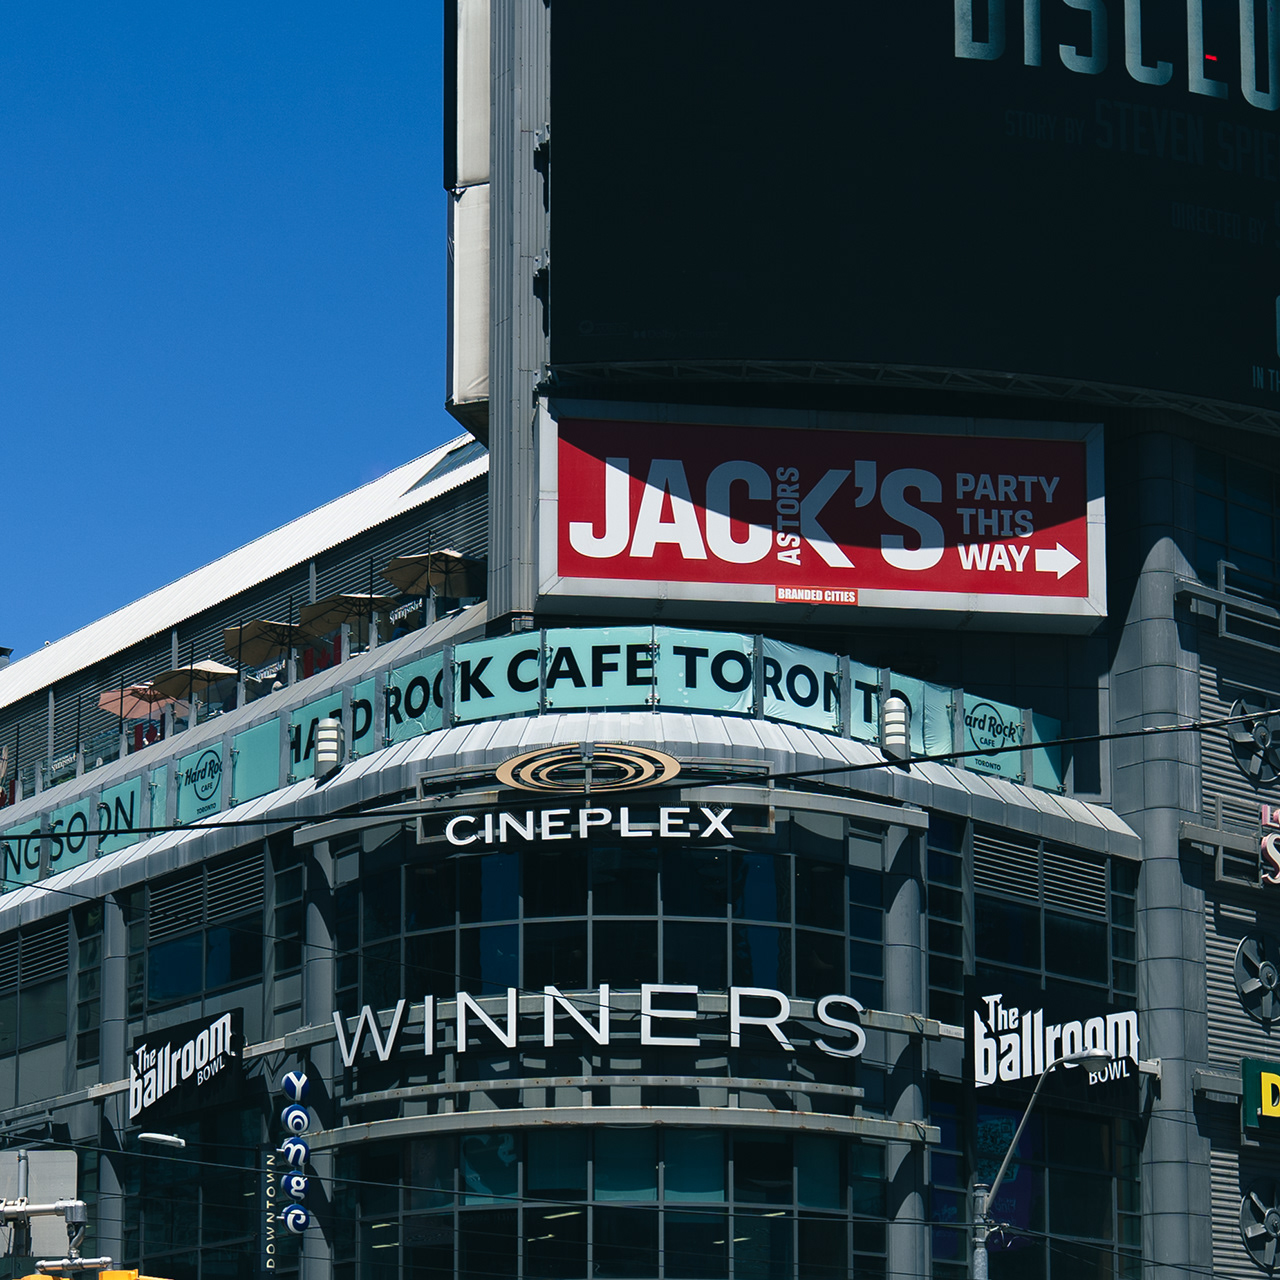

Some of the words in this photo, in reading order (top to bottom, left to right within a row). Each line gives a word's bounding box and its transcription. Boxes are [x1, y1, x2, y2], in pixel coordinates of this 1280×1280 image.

[1095, 99, 1204, 165] STEVEN
[1251, 365, 1264, 390] IN
[956, 472, 1060, 504] PARTY
[568, 457, 944, 571] JACK'S
[956, 507, 1034, 538] THIS
[957, 542, 1030, 573] WAY
[777, 588, 822, 602] BRANDED
[823, 589, 855, 603] CITIES
[507, 644, 658, 694] CAFE
[979, 736, 996, 748] CAFE
[988, 714, 1016, 743] Rock
[184, 764, 204, 788] Hard
[974, 757, 1002, 772] TORONTO
[200, 781, 214, 793] CAFE
[196, 802, 217, 815] TORONTO
[445, 806, 736, 846] CINEPLEX
[332, 983, 868, 1067] WINNERS
[982, 993, 1019, 1033] The
[135, 1042, 158, 1071] The
[974, 1008, 1140, 1088] ballroom
[129, 1012, 236, 1120] ballroom
[197, 1056, 226, 1086] BOWL
[1088, 1059, 1131, 1086] BOWL
[282, 1071, 310, 1234] Yonge
[266, 1154, 276, 1269] DOWNTOWN
